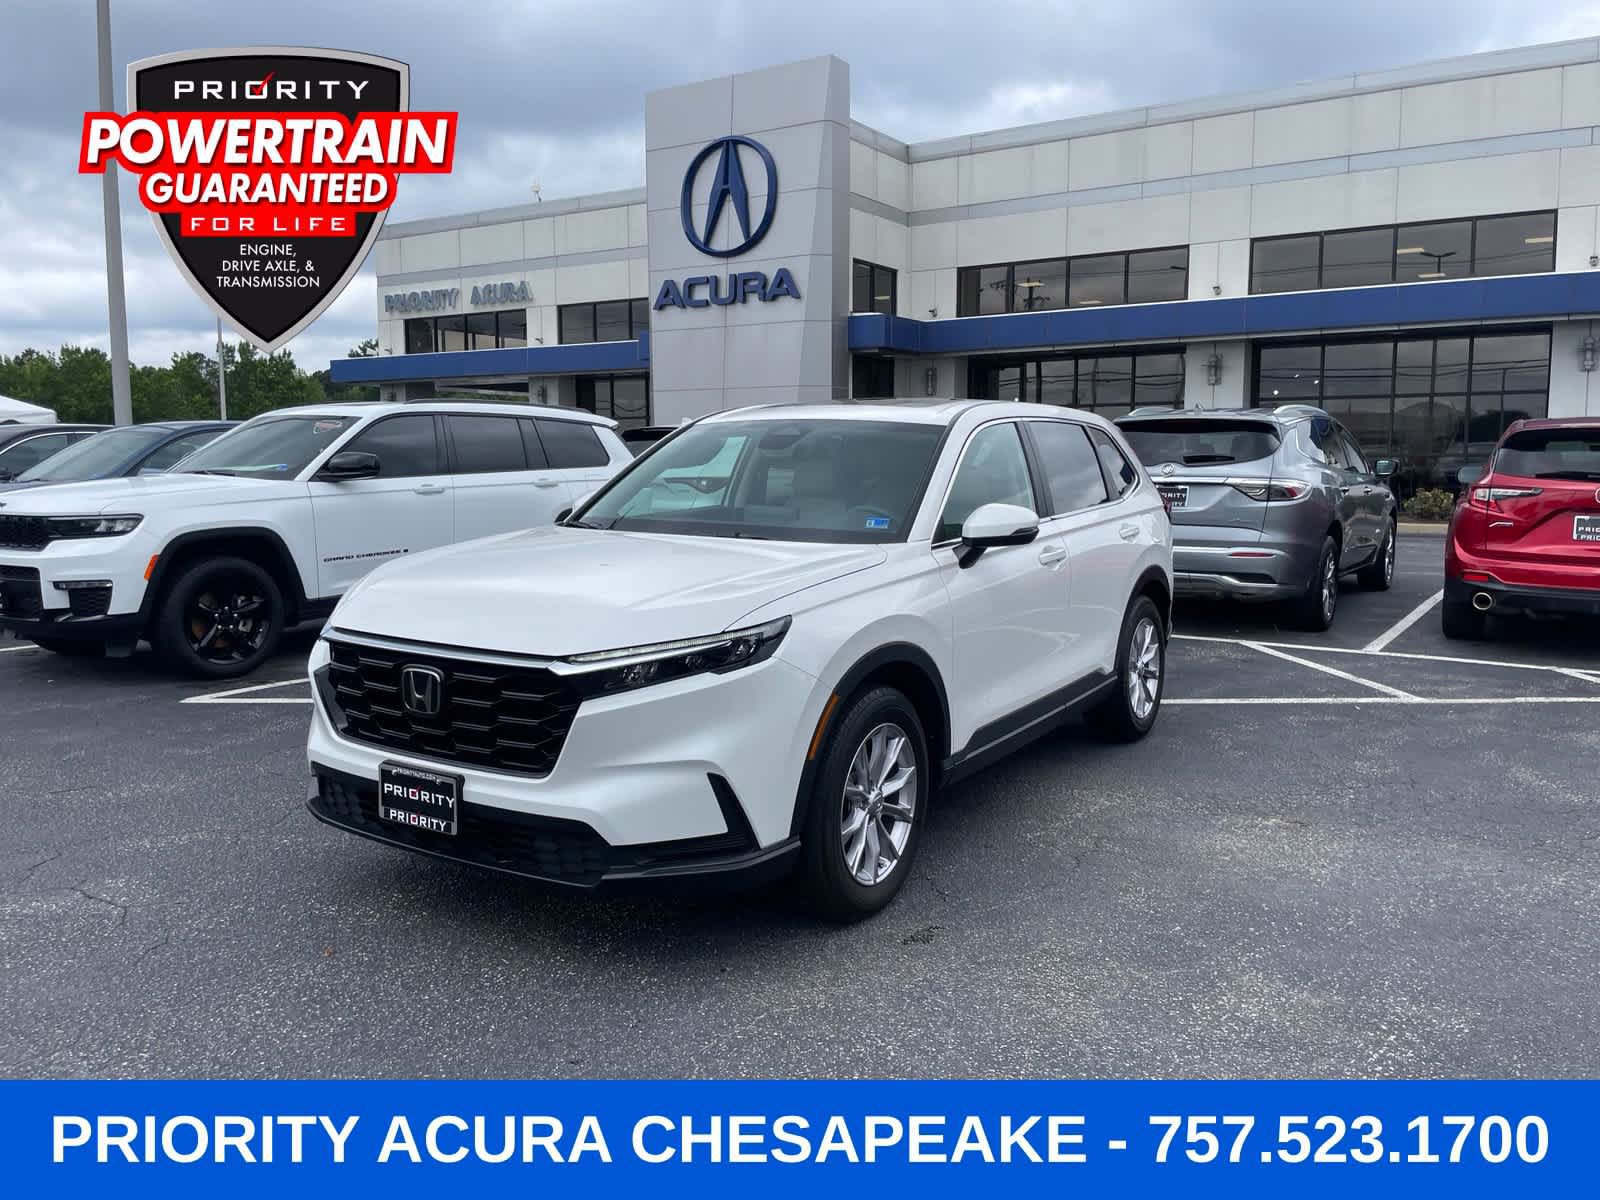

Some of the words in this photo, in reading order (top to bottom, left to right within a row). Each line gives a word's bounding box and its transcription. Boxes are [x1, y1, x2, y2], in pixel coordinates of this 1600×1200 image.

[384, 288, 459, 312] PRIORITY
[470, 281, 533, 305] ACURA
[653, 267, 801, 311] ACURA
[383, 782, 455, 809] PRIORITY
[389, 809, 447, 832] PRIORITY
